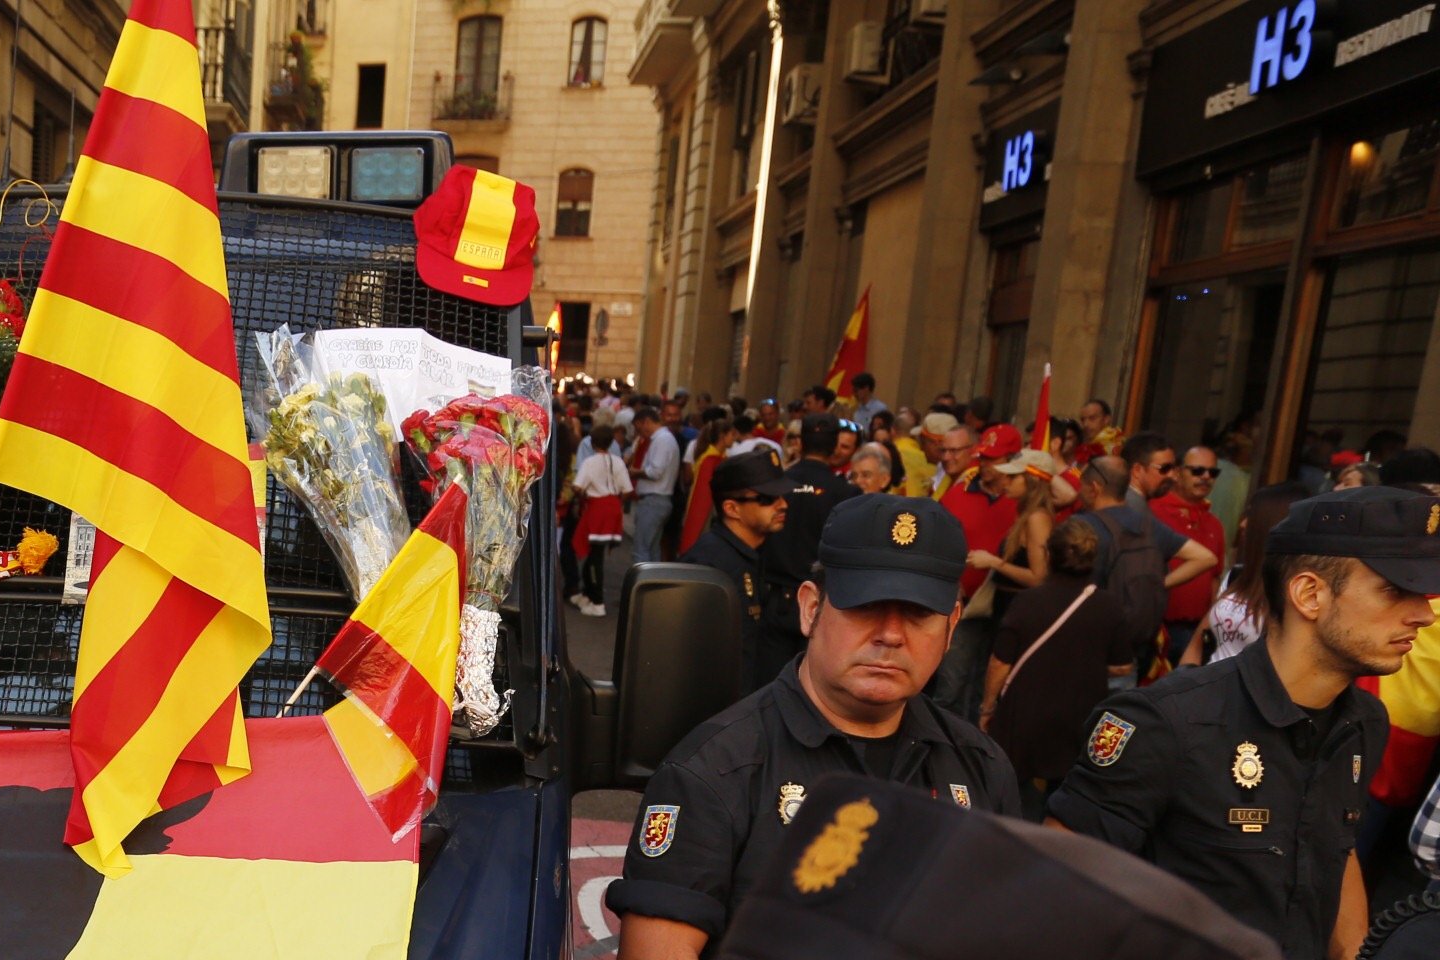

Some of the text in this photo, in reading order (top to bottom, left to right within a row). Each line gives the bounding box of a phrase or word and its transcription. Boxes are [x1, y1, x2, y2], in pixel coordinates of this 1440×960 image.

[1249, 0, 1316, 96] H3
[1002, 130, 1035, 193] H3
[463, 243, 500, 260] ESPAÑA
[390, 339, 419, 354] POR
[338, 352, 354, 368] Y
